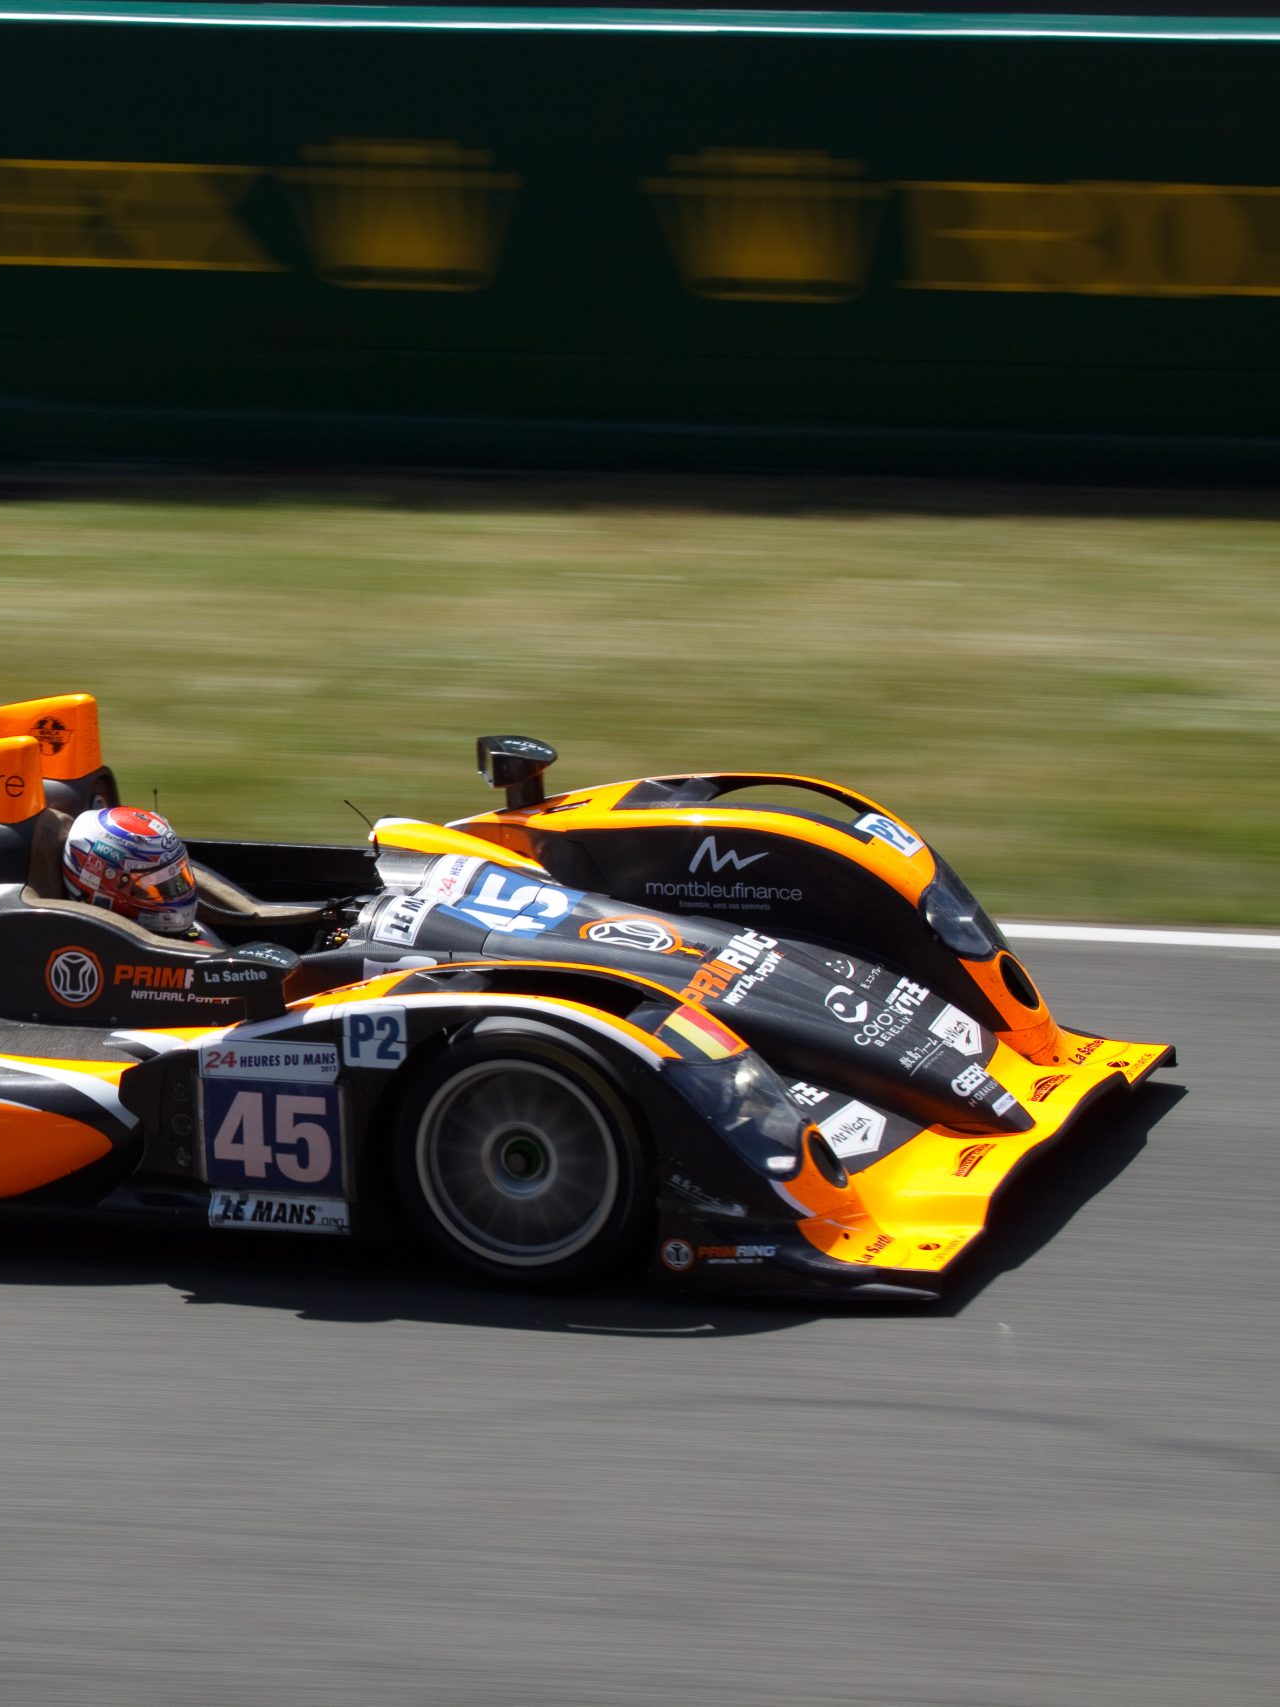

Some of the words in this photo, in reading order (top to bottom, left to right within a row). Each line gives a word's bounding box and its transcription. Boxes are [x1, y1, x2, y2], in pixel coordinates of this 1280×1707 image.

[867, 816, 918, 851] P2
[96, 843, 121, 861] NOVA
[460, 873, 569, 932] 45
[645, 880, 803, 902] montbleufinance
[203, 971, 220, 984] La
[222, 969, 269, 984] Sarthe
[130, 989, 185, 1003] NATURAL
[348, 1014, 401, 1061] P2
[205, 1051, 238, 1069] 24
[239, 1055, 280, 1068] HEURES
[283, 1054, 300, 1067] DU
[303, 1053, 336, 1066] MANS
[213, 1091, 333, 1184] 45
[220, 1199, 247, 1222] LE
[251, 1200, 316, 1225] MANS
